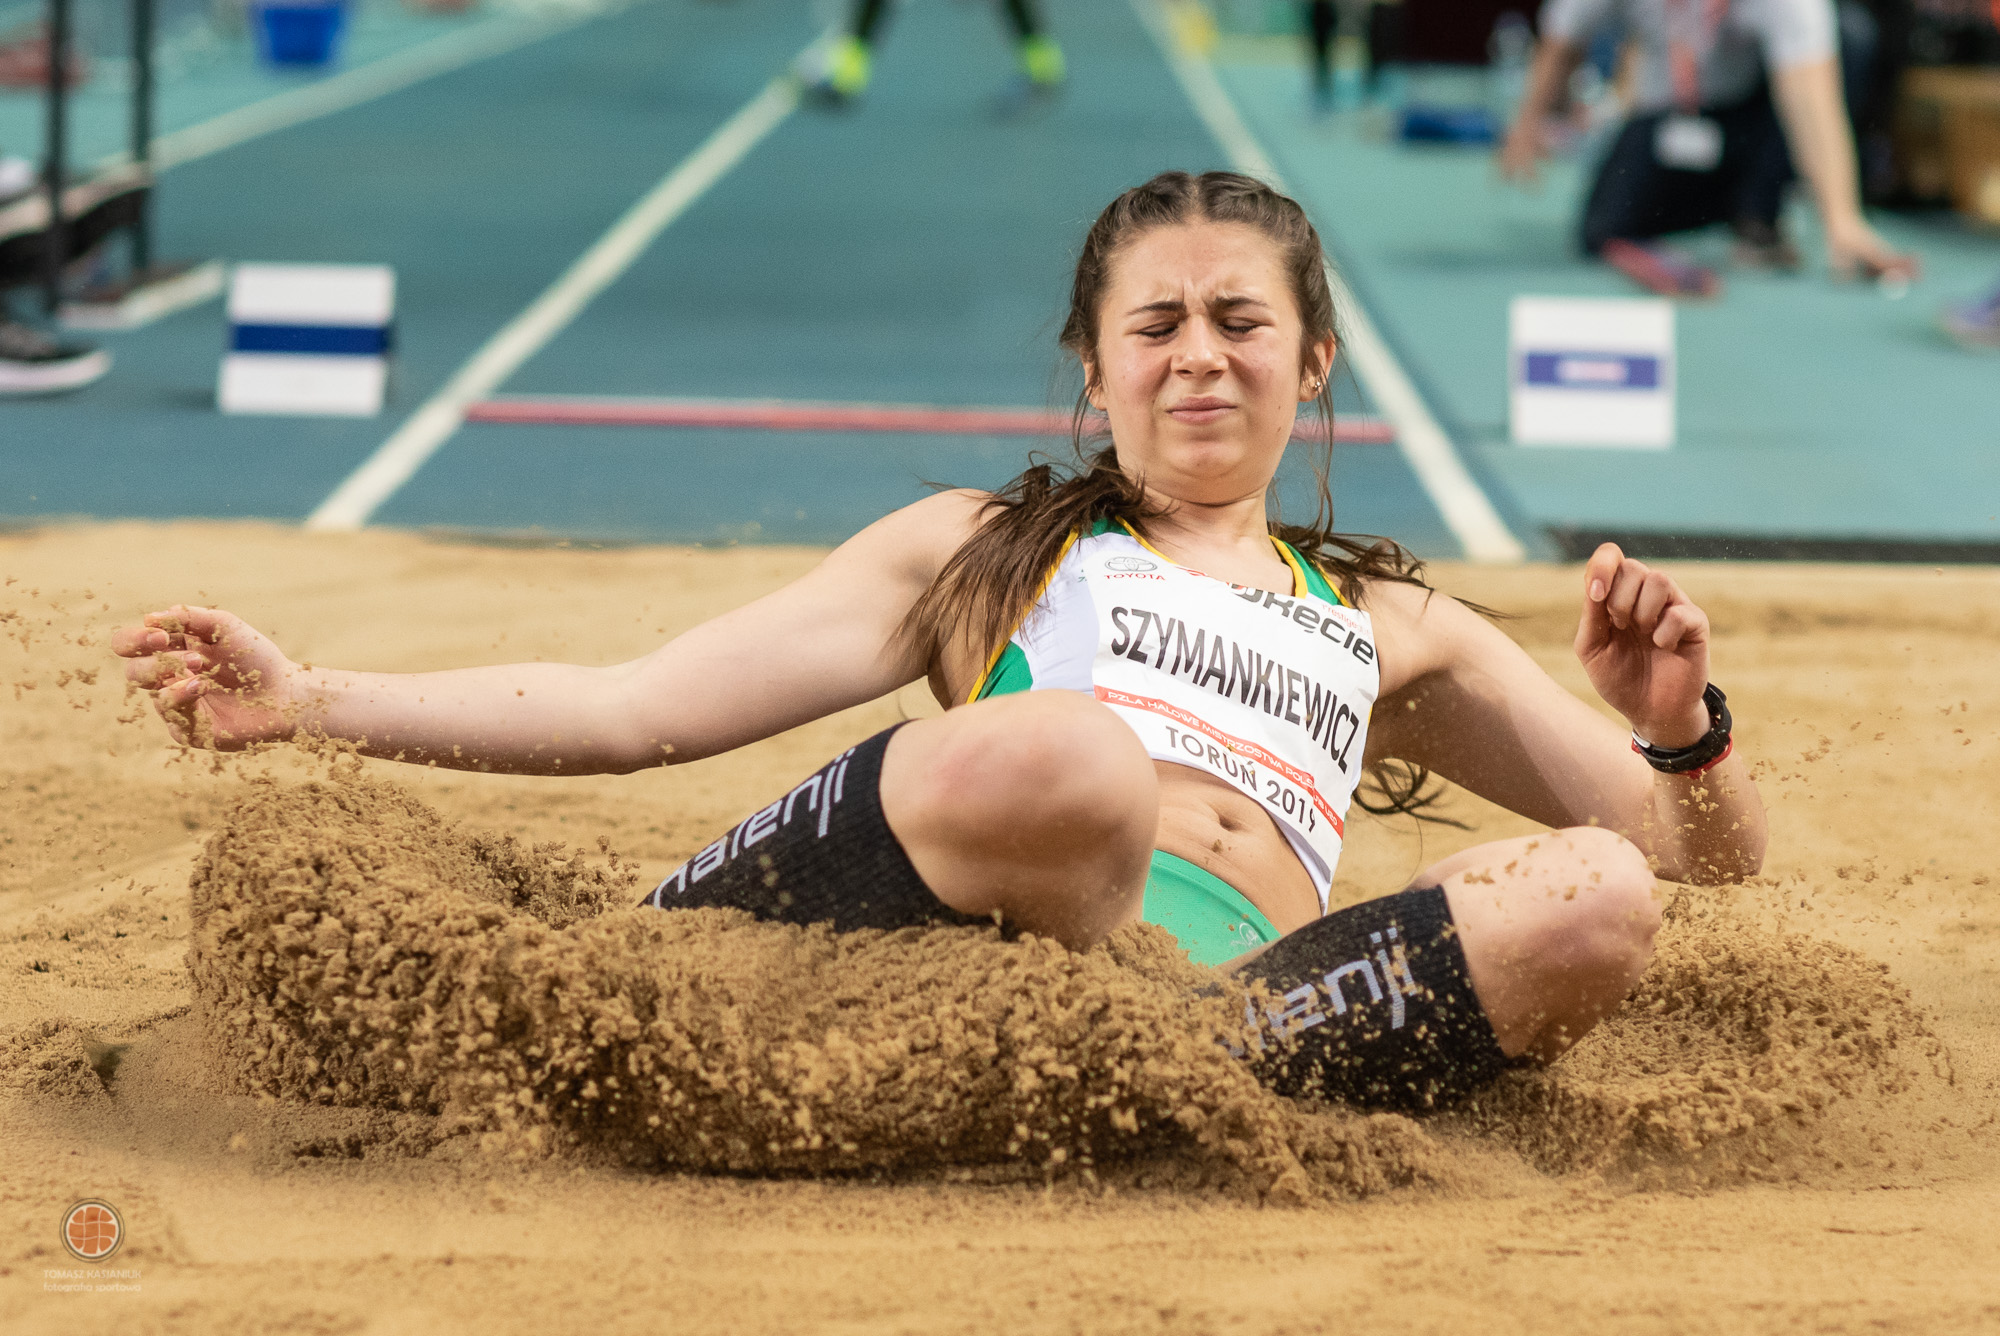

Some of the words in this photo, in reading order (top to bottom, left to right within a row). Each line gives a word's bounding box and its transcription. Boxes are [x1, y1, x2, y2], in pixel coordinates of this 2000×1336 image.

[1104, 573, 1166, 581] TOYOTA
[1111, 606, 1359, 774] SZYMANKIEWICZ
[1107, 691, 1145, 707] PZLA
[1147, 701, 1200, 727] HALOWE
[1202, 723, 1284, 771] MISTRZOSTWA
[1165, 725, 1258, 792] TORUŃ
